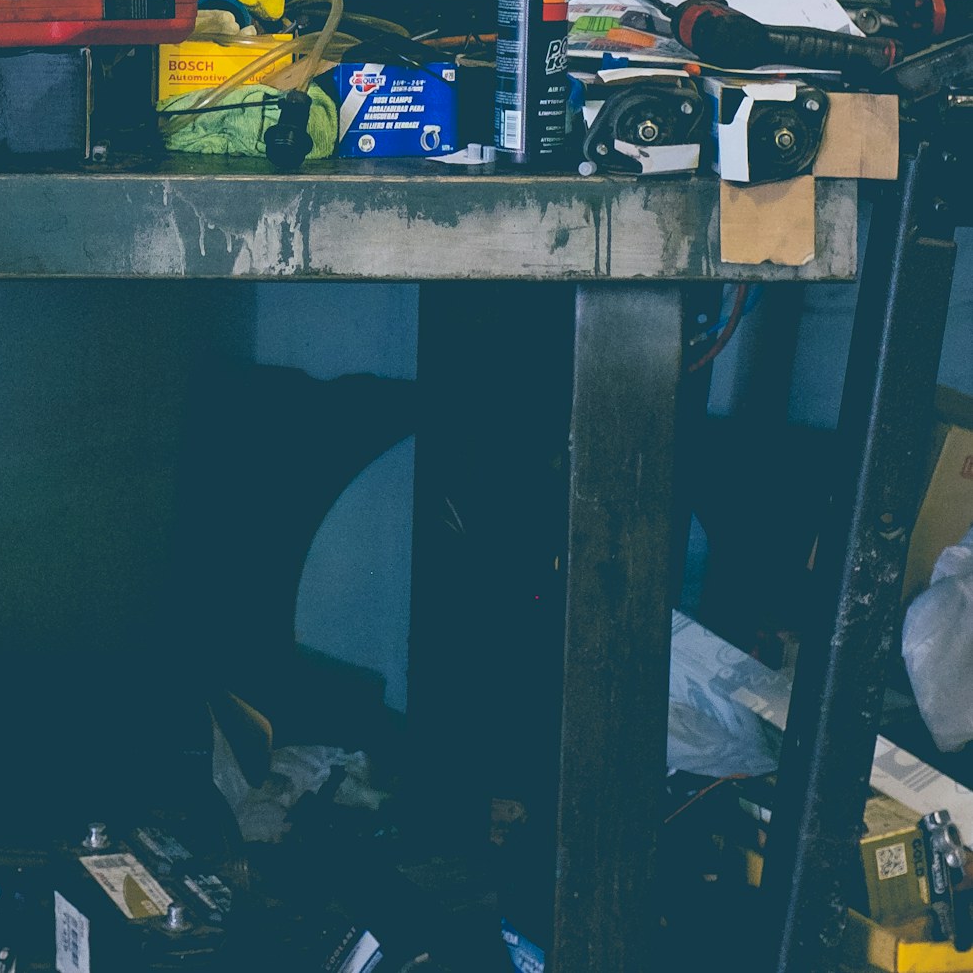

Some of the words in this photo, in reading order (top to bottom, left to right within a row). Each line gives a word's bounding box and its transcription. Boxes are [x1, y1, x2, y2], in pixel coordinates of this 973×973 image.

[168, 60, 214, 71] BOSCH
[168, 74, 228, 82] Automotive
[372, 96, 388, 104] HOSE
[388, 96, 413, 104] CLAMPS
[367, 105, 409, 113] ABRAZADERAS
[408, 105, 425, 113] PARA
[358, 122, 385, 130] COLLIERS
[385, 121, 394, 129] DE
[326, 926, 356, 971] COOLANT
